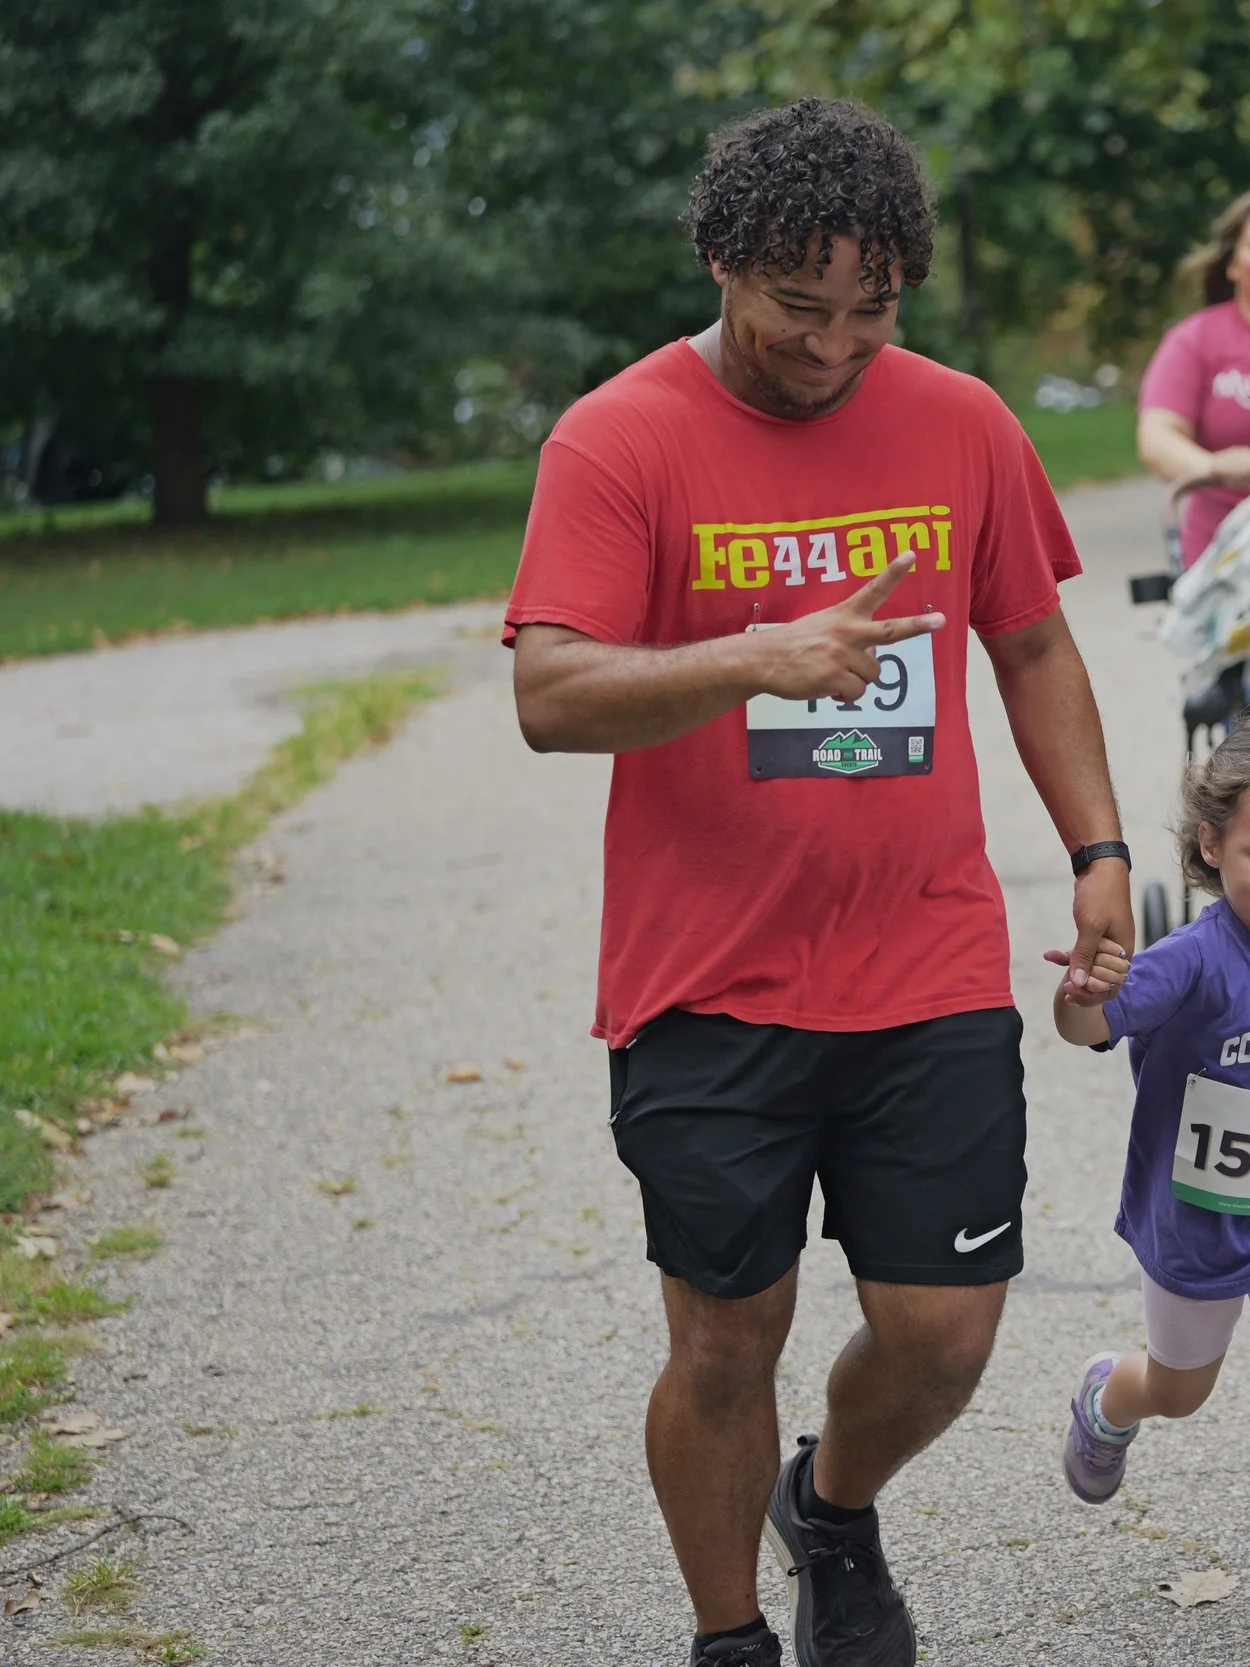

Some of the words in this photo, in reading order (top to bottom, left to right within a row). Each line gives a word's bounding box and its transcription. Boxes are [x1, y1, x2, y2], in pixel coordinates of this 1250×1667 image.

[692, 505, 952, 590] Fe44ari
[812, 749, 841, 762] ROAD
[854, 748, 883, 761] TRAIL
